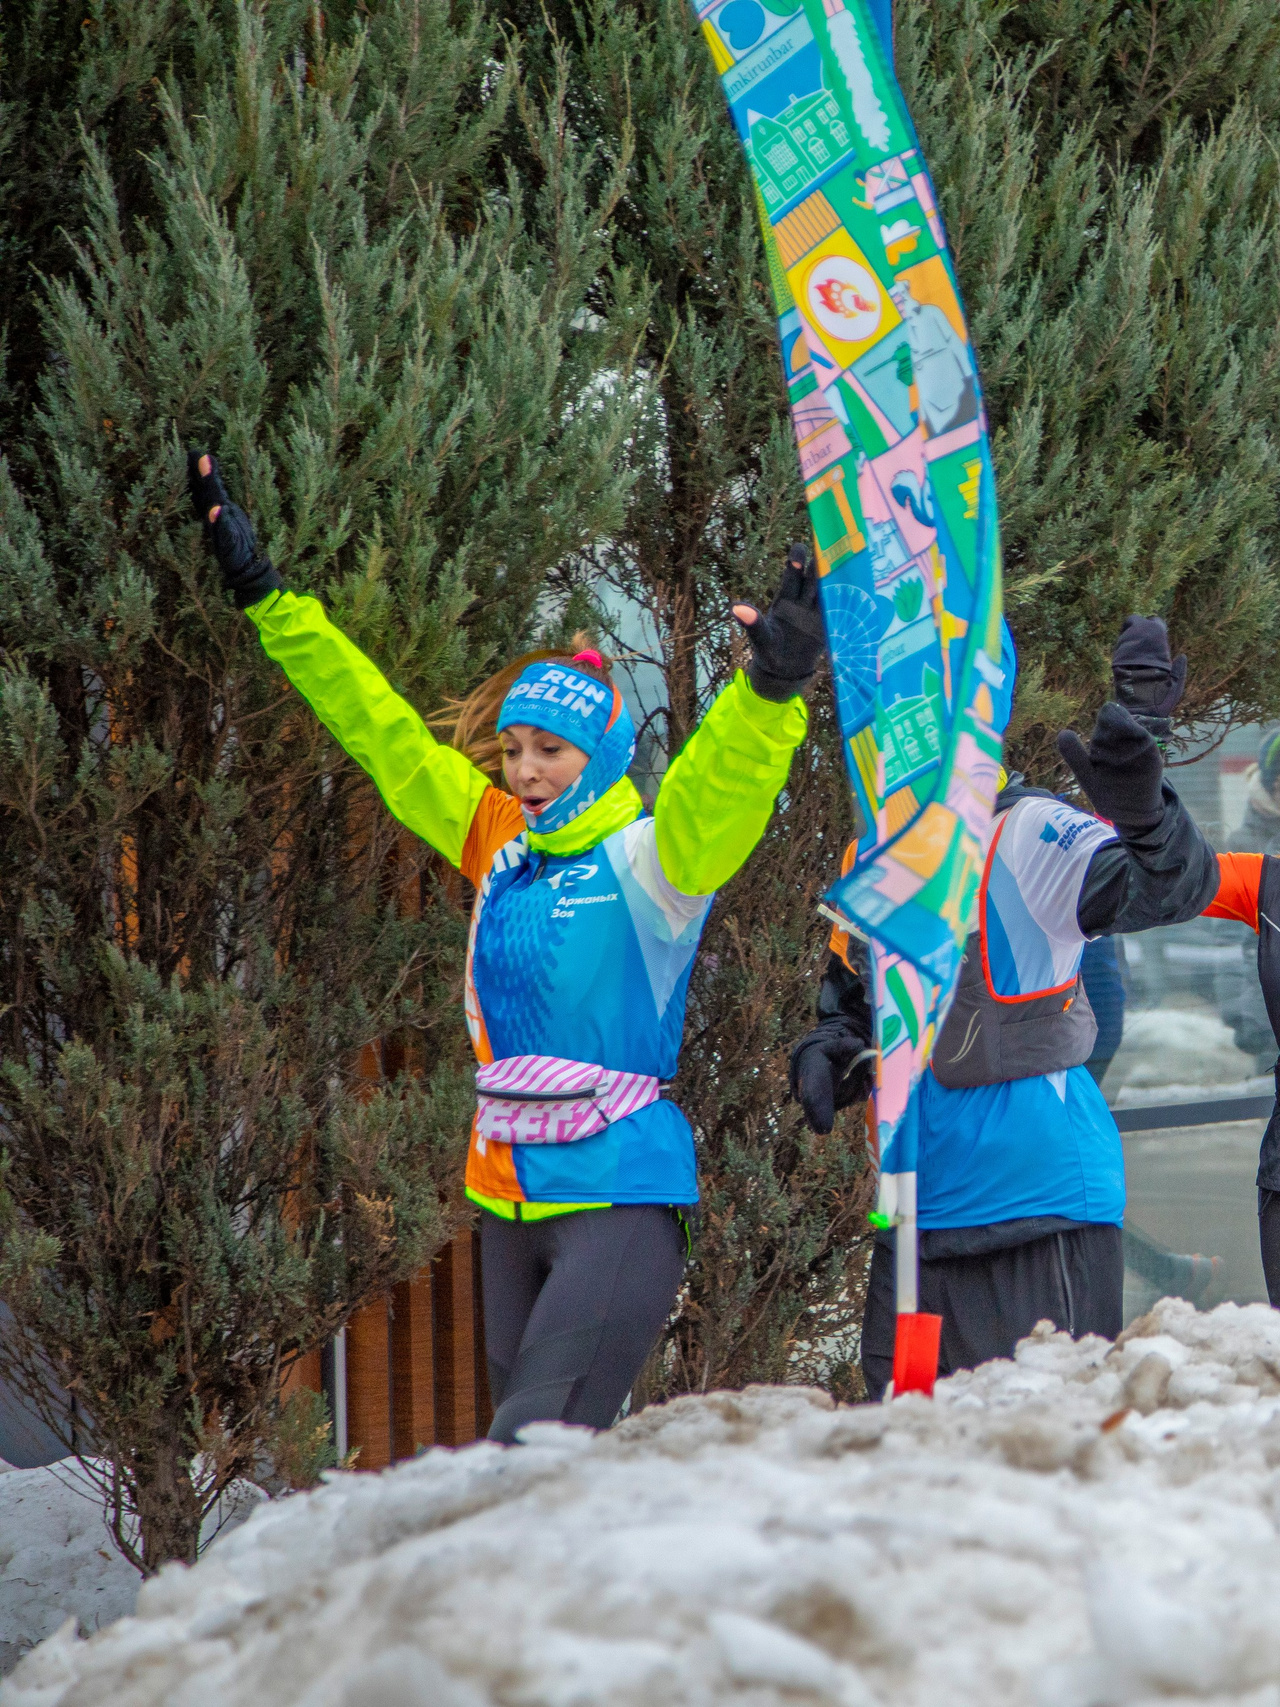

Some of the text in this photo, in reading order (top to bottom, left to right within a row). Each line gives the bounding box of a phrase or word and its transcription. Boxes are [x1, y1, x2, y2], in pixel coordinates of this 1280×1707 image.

[540, 669, 606, 704] RUN
[517, 702, 560, 717] running
[561, 711, 582, 728] club
[1057, 822, 1077, 848] RUN
[551, 908, 576, 919] Зоя
[556, 893, 619, 908] Аржаных
